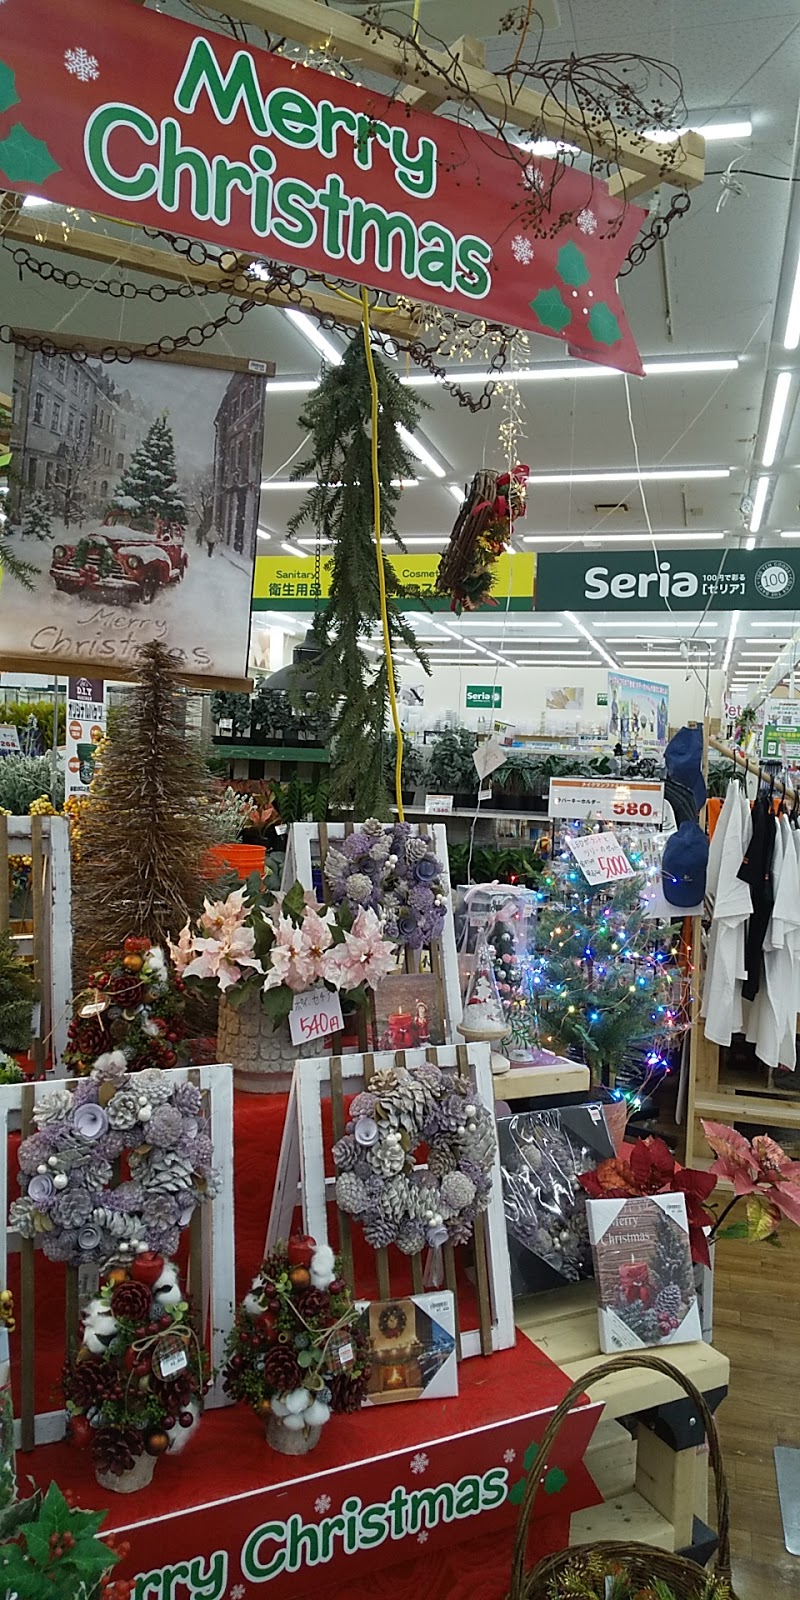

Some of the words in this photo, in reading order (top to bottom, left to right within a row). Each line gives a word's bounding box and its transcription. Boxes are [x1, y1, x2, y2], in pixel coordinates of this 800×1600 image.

[174, 36, 438, 198] Merry
[84, 102, 492, 299] Christmas
[275, 570, 317, 580] Sanitary
[402, 569, 440, 579] Cosmet
[584, 562, 698, 599] Seria
[763, 571, 787, 588] 100
[268, 583, 322, 597] 衛生用品
[77, 608, 168, 638] Merry
[30, 626, 213, 666] Christas
[466, 691, 491, 700] Seria
[299, 1012, 340, 1039] 540円
[600, 1231, 651, 1246] Christmas
[131, 1550, 229, 1600] rry
[240, 1466, 510, 1584] Christmas
